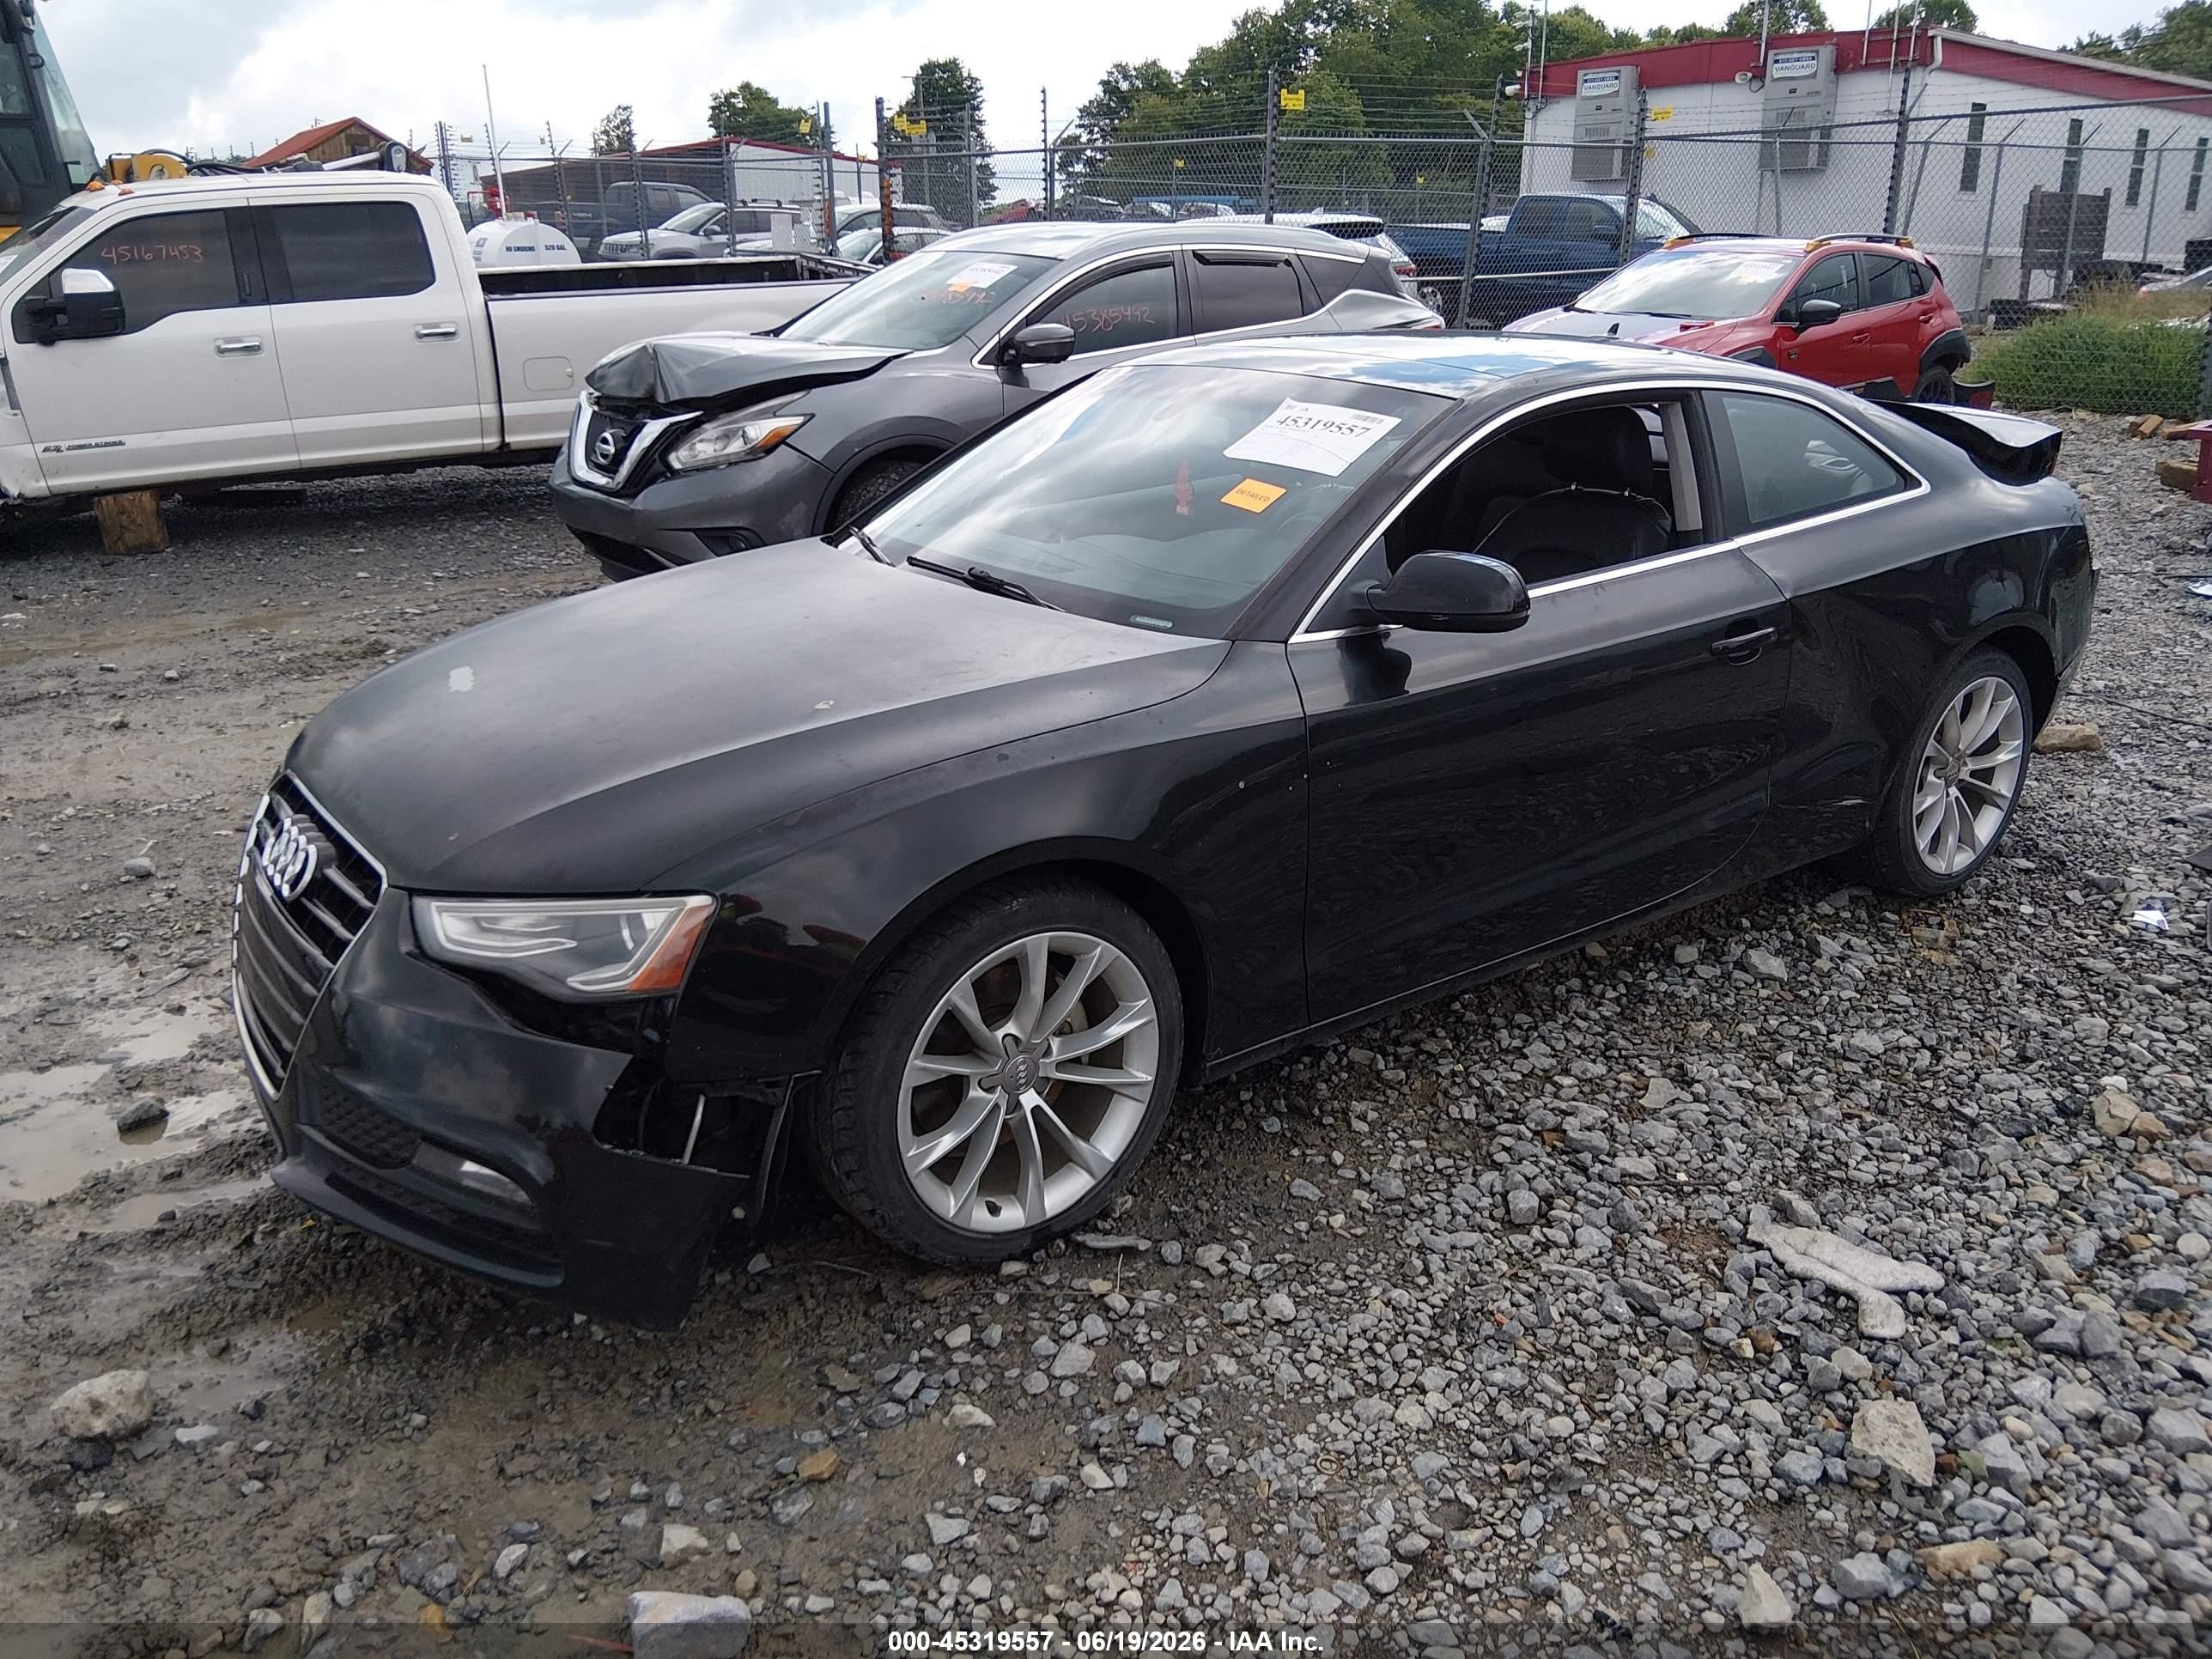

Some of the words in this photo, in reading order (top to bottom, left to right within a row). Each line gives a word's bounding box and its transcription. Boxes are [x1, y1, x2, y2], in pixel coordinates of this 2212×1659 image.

[1774, 63, 1816, 72] VANGUARD
[1583, 82, 1618, 91] VANGUARD
[100, 245, 204, 264] 45167453
[1277, 415, 1372, 437] 45319557
[1237, 489, 1271, 502] DETAILED
